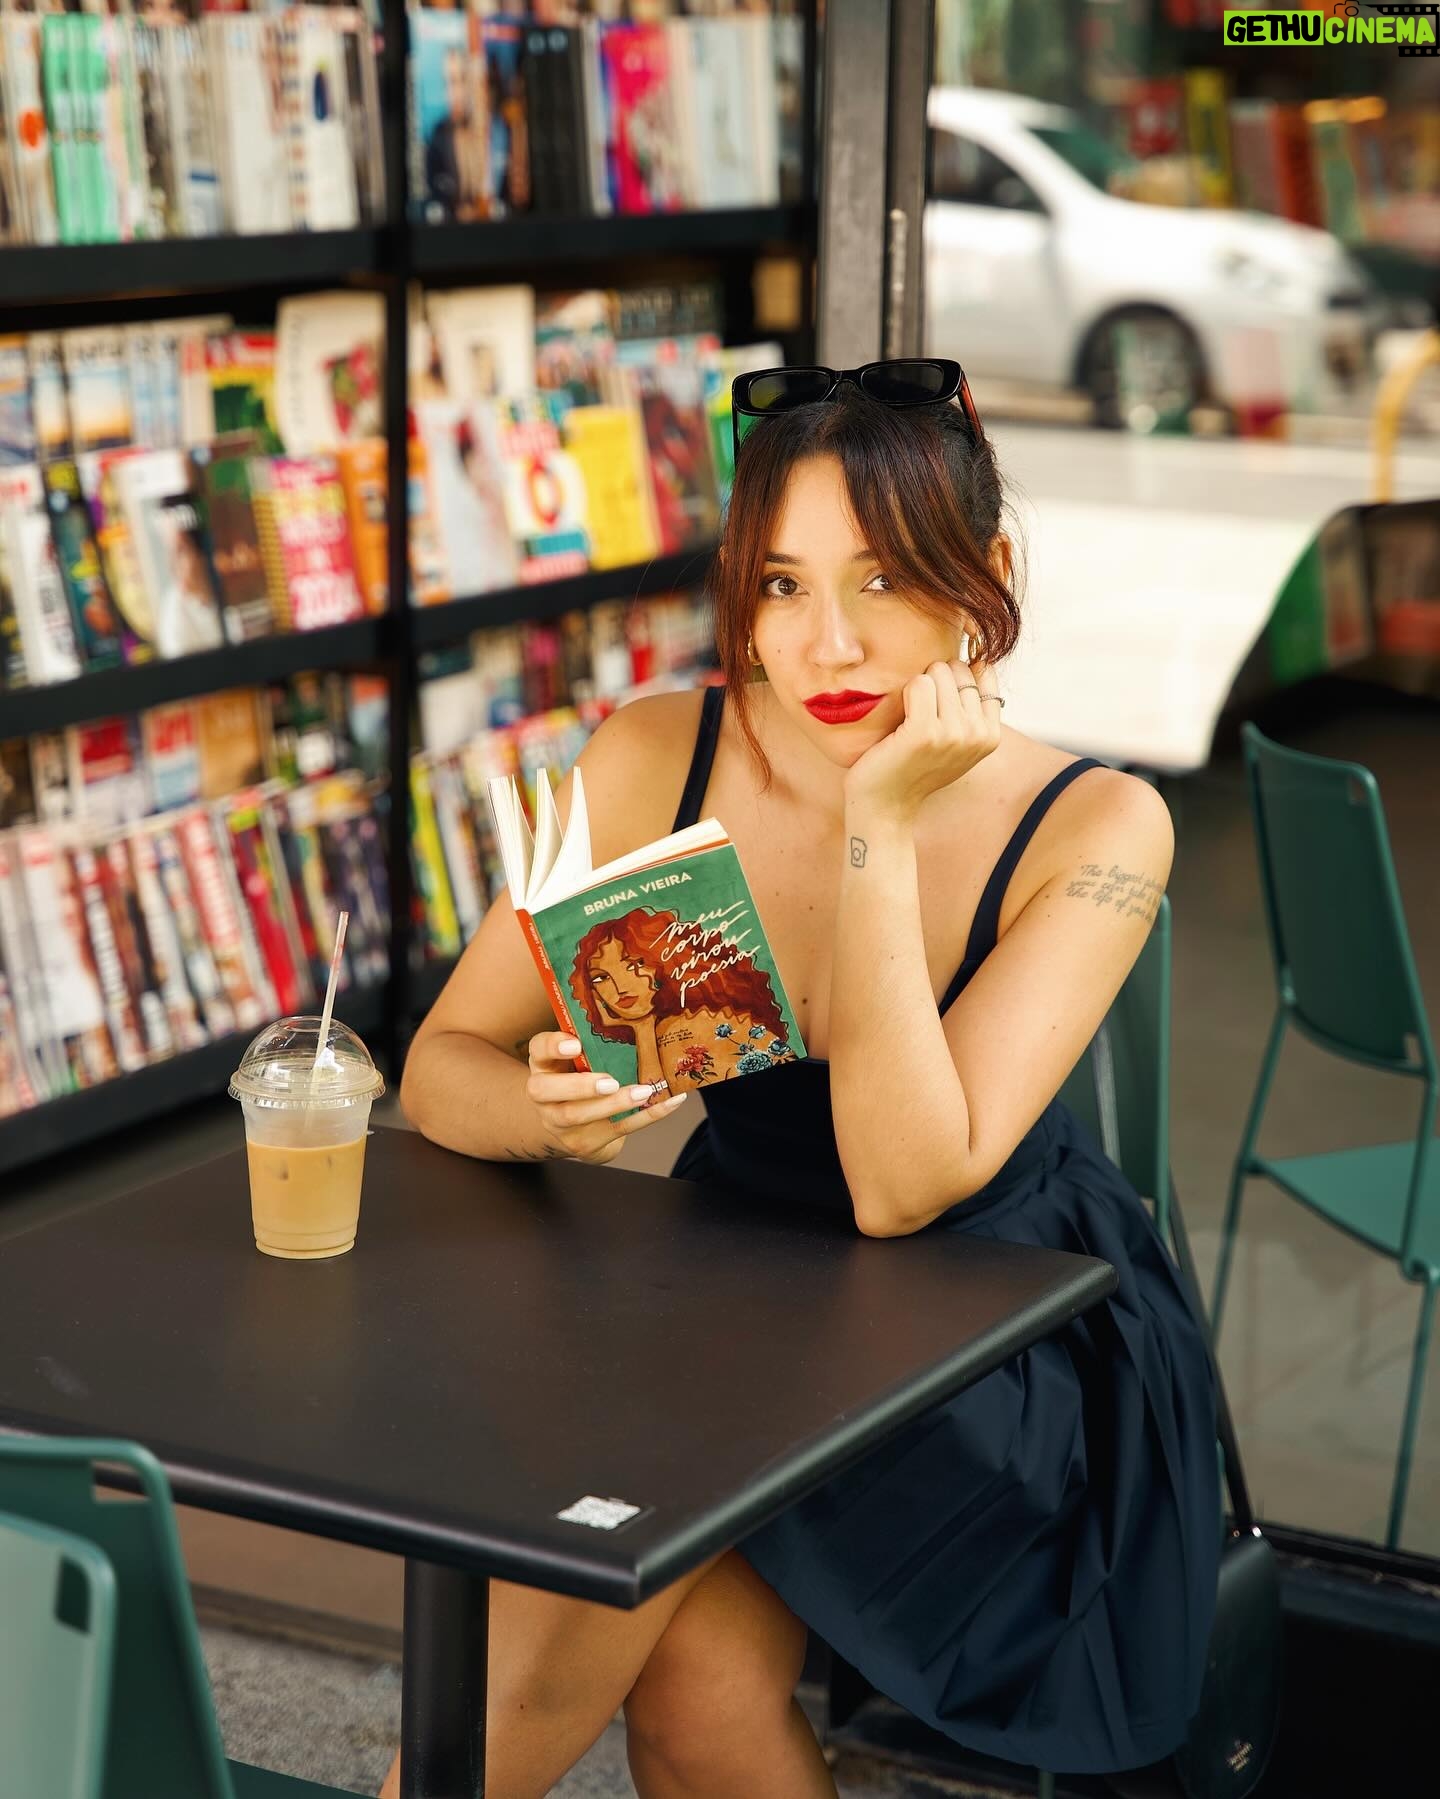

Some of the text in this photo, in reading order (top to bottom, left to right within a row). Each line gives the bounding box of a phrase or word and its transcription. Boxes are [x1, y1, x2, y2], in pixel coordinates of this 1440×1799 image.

[583, 871, 693, 917] BRUNA VIEIRA
[649, 900, 745, 950] meu
[661, 910, 750, 962] corpo
[670, 928, 753, 980] virou
[680, 945, 761, 1009] poesia
